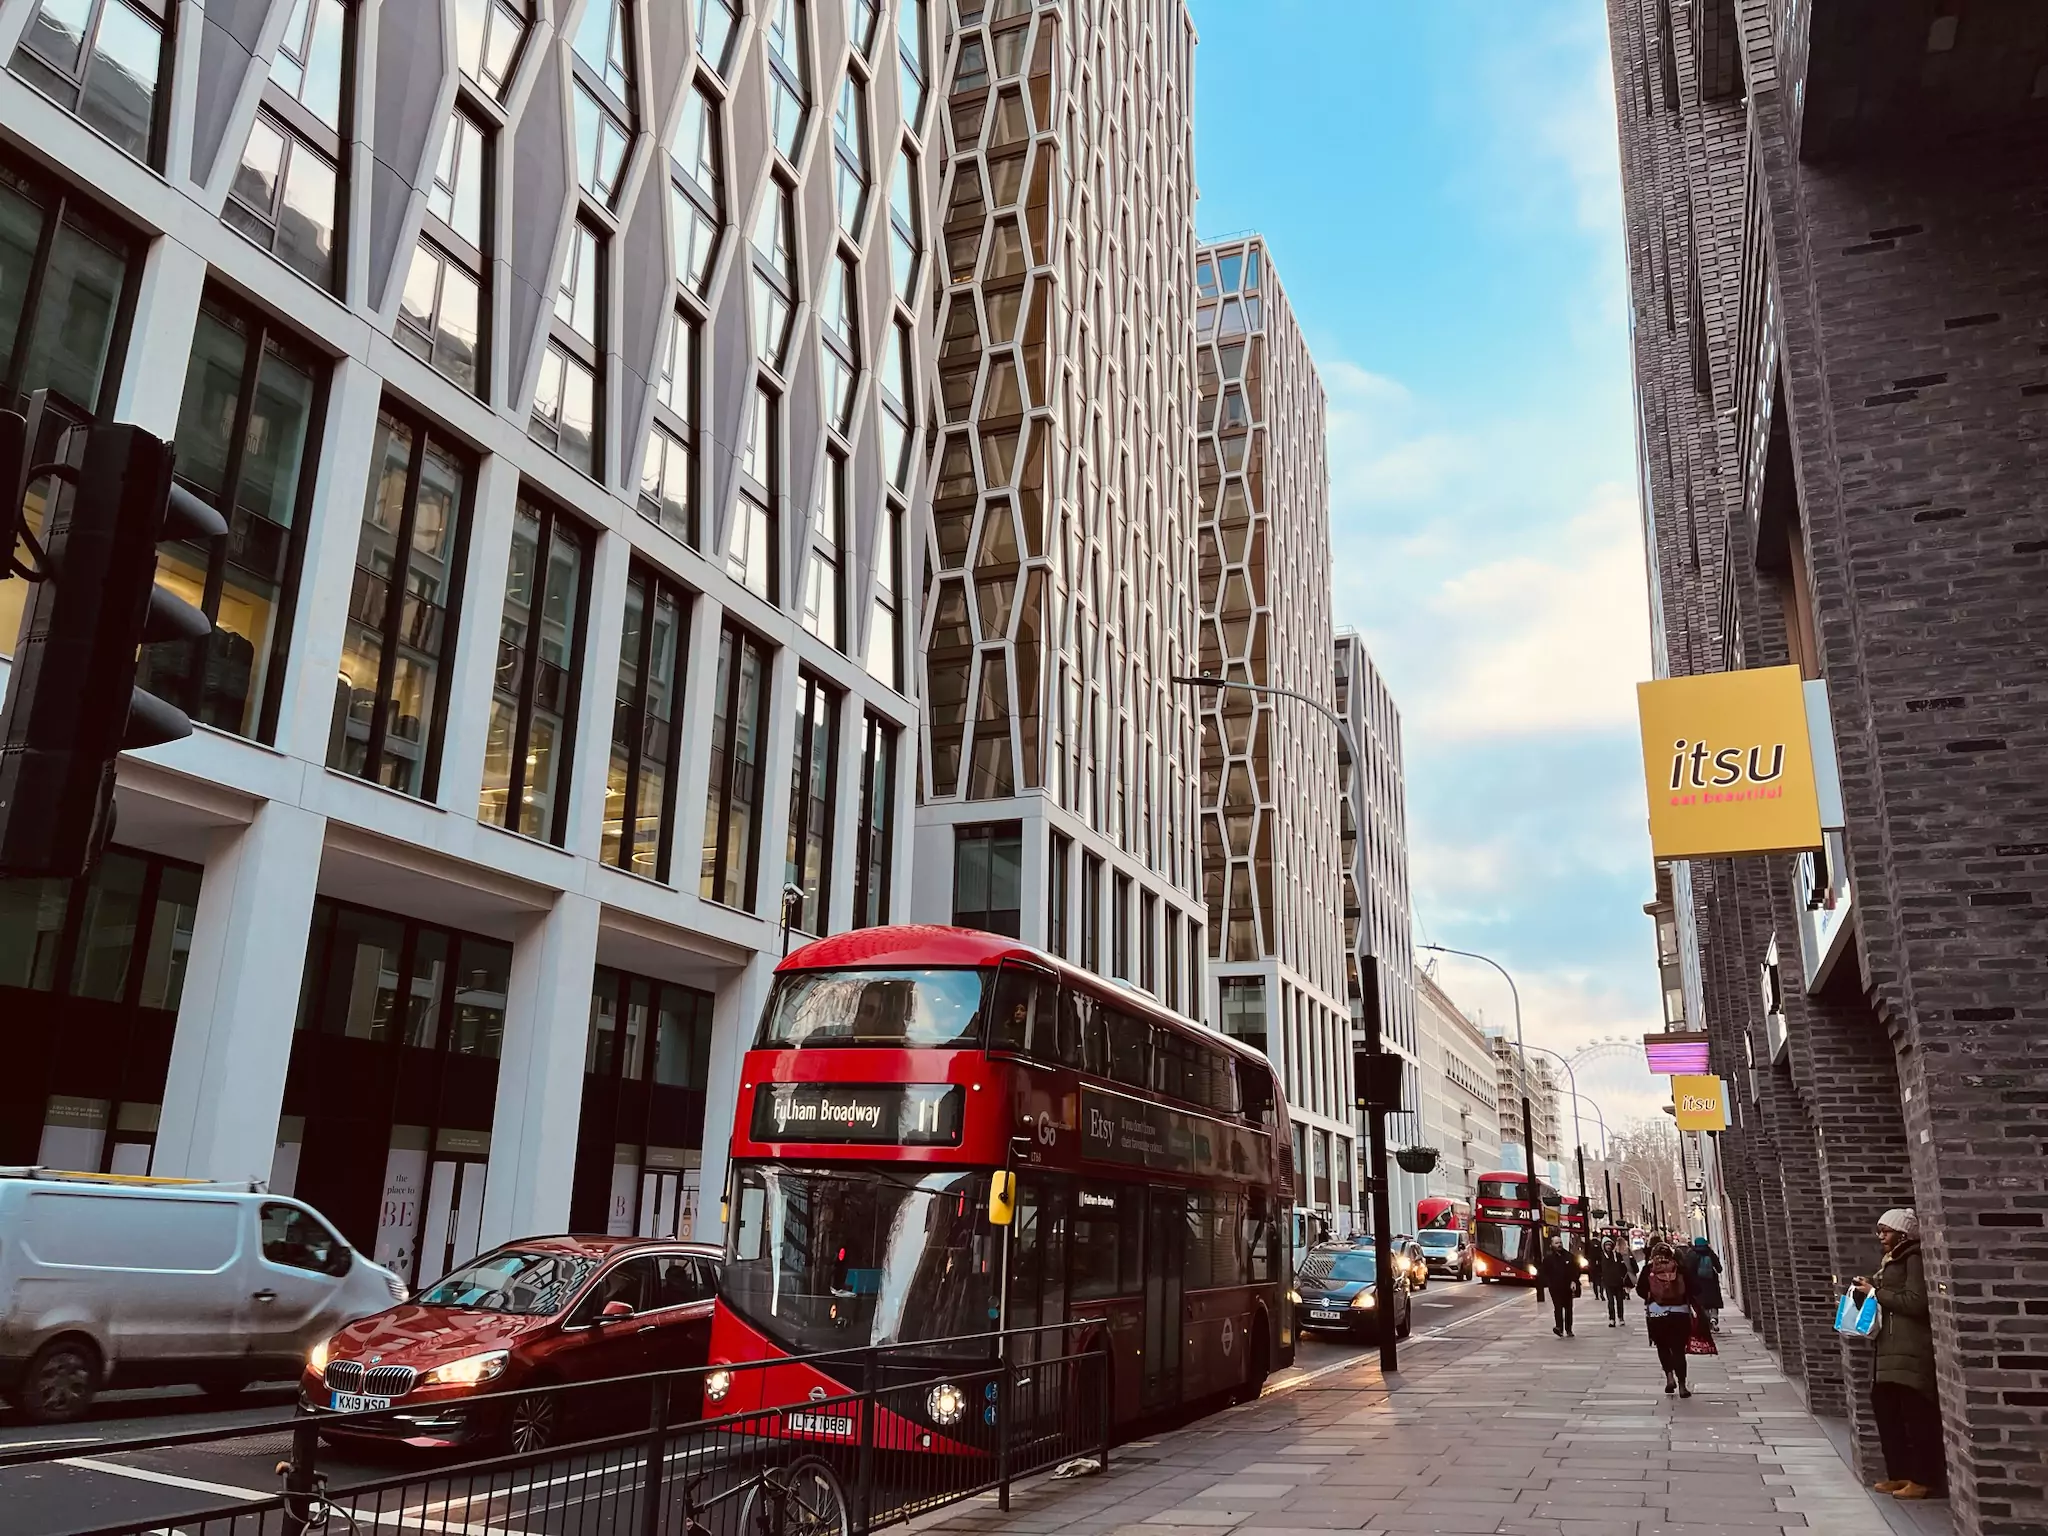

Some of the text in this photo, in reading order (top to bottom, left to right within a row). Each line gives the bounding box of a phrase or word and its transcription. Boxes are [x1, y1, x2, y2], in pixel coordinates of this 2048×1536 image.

[1670, 738, 1785, 790] itsu
[1671, 786, 1782, 806] eat beautiful
[1682, 1094, 1716, 1111] itsu
[773, 1098, 940, 1132] Fulham Broadway 11
[1090, 1108, 1115, 1147] Etsy
[396, 1174, 408, 1182] the
[387, 1185, 406, 1196] place
[380, 1201, 414, 1227] BE
[339, 1395, 361, 1410] KX19
